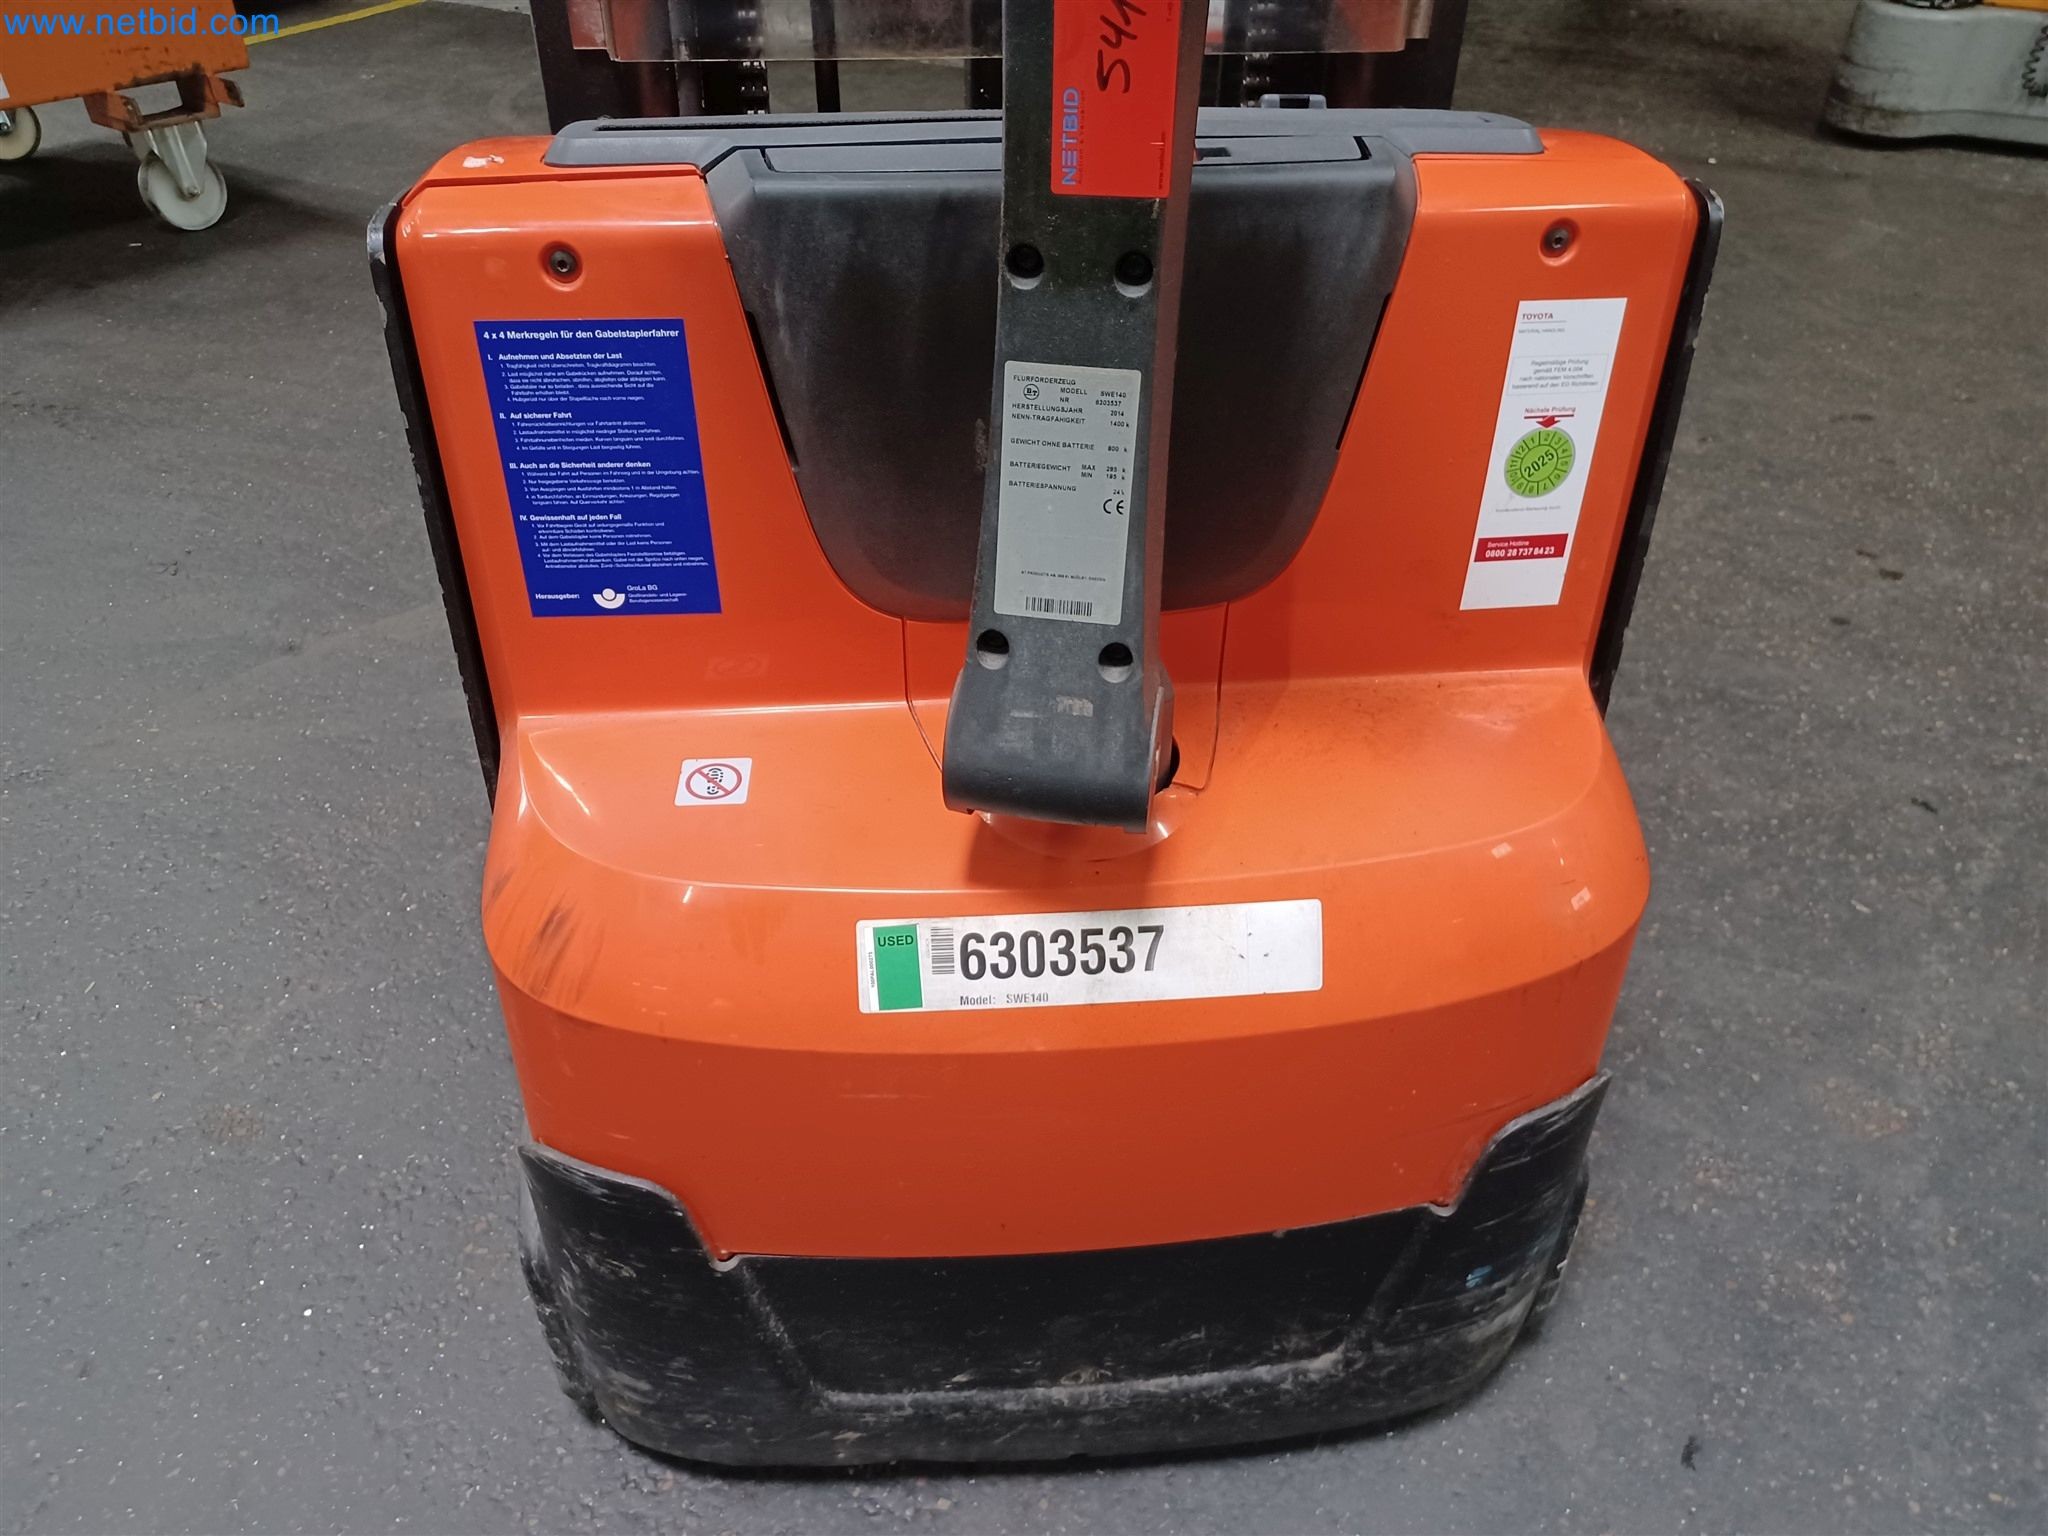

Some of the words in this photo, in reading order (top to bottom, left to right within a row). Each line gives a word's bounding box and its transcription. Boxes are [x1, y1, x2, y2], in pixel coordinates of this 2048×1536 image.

[1062, 88, 1080, 185] NETBID
[499, 331, 505, 339] 4
[507, 331, 558, 340] Merkregeln
[561, 330, 573, 338] für
[576, 330, 592, 338] den
[595, 329, 679, 340] Gabelstaplerfahrer
[1012, 404, 1083, 414] HERSTELLUNGSJAHR
[1011, 438, 1040, 446] GEWICHT
[1062, 442, 1094, 450] BATTERIE
[1010, 461, 1071, 472] BATTERIEGEWICHT
[1524, 449, 1555, 478] 2025
[1009, 480, 1077, 491] BATTERIESPANNUNG
[1103, 498, 1124, 515] CE
[1485, 550, 1505, 558] 0800
[1507, 549, 1517, 557] 28
[1518, 547, 1532, 556] 737
[878, 935, 914, 947] USED
[960, 925, 1164, 980] 6303537
[960, 995, 996, 1006] Model:
[1006, 992, 1049, 1004] SWE140
